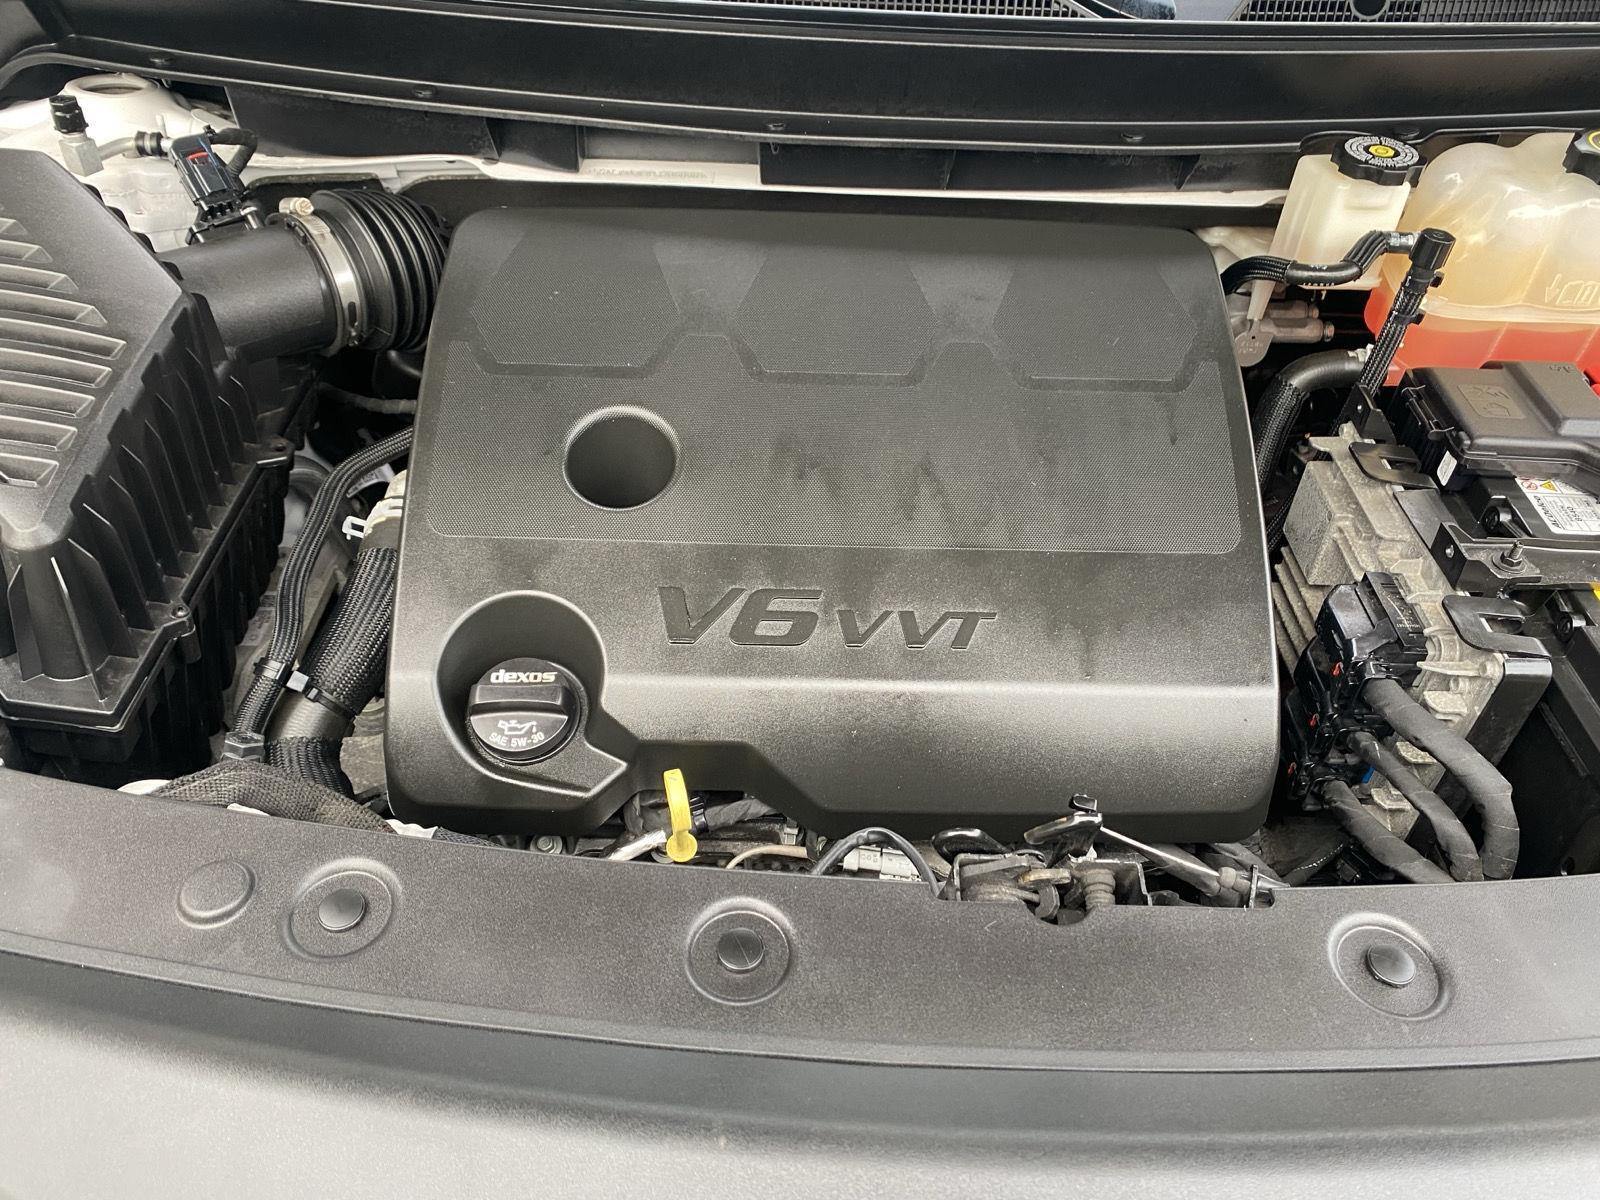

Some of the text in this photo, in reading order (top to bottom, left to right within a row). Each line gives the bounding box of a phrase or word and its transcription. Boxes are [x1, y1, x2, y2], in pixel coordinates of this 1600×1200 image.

[657, 586, 998, 650] V6 VVT
[489, 669, 558, 684] dexos
[489, 731, 545, 747] SAE 5W-30
